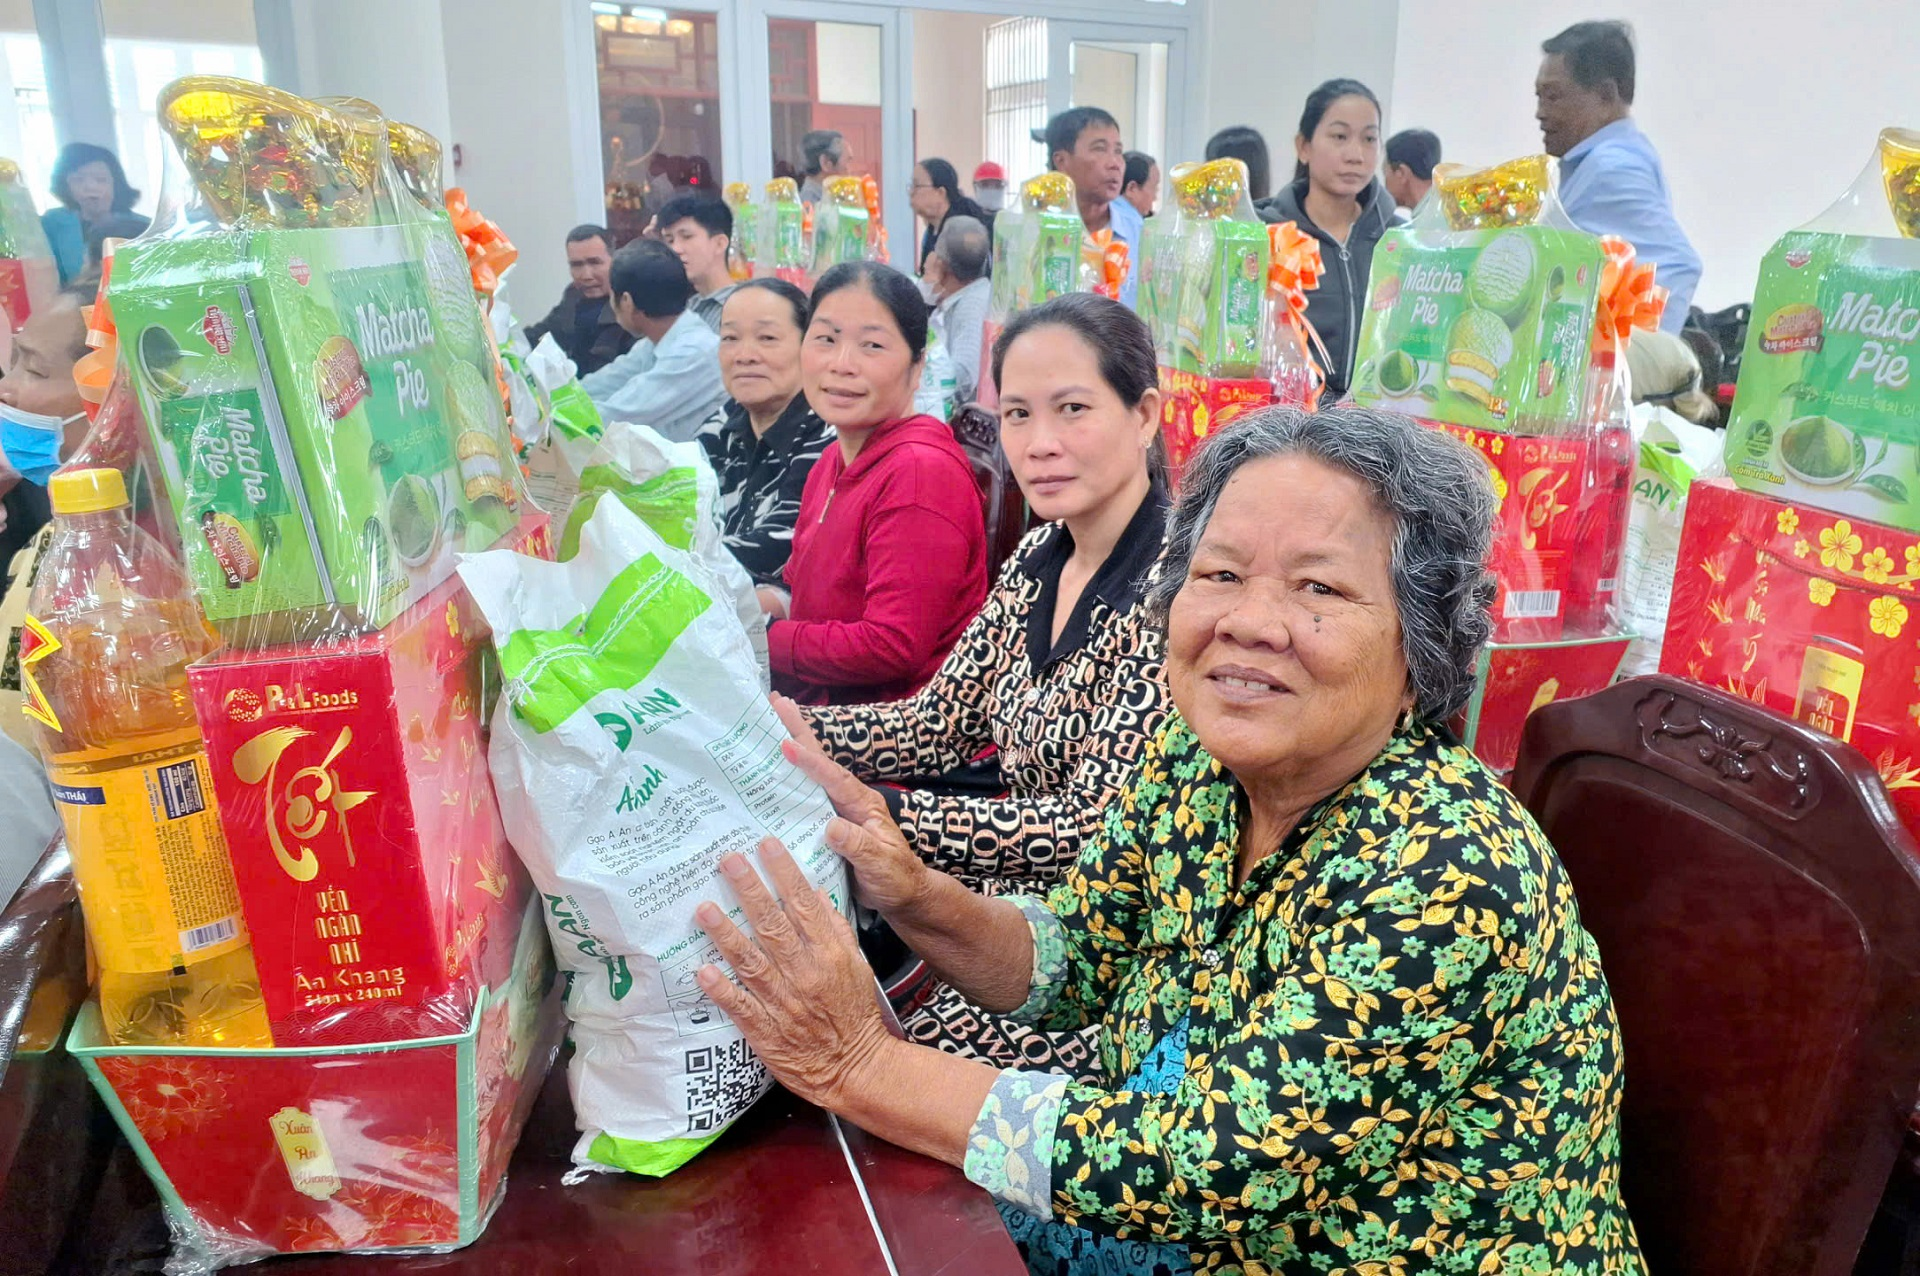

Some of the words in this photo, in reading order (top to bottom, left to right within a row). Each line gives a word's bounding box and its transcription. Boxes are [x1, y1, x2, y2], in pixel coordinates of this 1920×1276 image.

[1403, 263, 1464, 294] Matcha
[356, 292, 435, 362] Matcha
[1410, 296, 1439, 326] Pie
[1828, 292, 1920, 342] Matc
[1848, 341, 1910, 388] Pie
[393, 358, 430, 417] Pie
[203, 435, 231, 480] Pie
[220, 406, 270, 505] Matcha
[1633, 478, 1671, 506] AN
[1518, 466, 1570, 551] Tết
[313, 690, 359, 709] Foods
[232, 725, 378, 882] Tết
[746, 781, 766, 799] Năng
[753, 791, 779, 810] Protein
[587, 835, 606, 845] Gạo
[608, 830, 616, 840] A
[619, 827, 632, 837] An
[658, 796, 675, 817] chất
[762, 805, 781, 821] Gluxit
[796, 830, 813, 844] công
[818, 811, 835, 826] chất
[611, 838, 631, 851] xuất
[634, 833, 652, 844] trên
[653, 818, 673, 837] cánh
[628, 883, 648, 898] Gạo
[649, 877, 656, 888] A
[656, 872, 668, 883] An
[668, 861, 690, 876] được
[690, 851, 705, 864] sản
[703, 839, 720, 854] xuất
[634, 892, 657, 909] công
[658, 877, 680, 894] nghệ
[681, 867, 700, 881] hiện
[701, 856, 715, 870] đại
[315, 884, 350, 913] YẾN
[639, 910, 650, 921] ra
[650, 900, 667, 914] sản
[667, 886, 692, 906] phẩm
[692, 875, 710, 891] gạo
[726, 906, 744, 919] ƠM:
[575, 909, 591, 931] Ngon
[656, 937, 688, 963] HƯỚNG
[334, 966, 407, 986] Khang
[279, 1120, 314, 1136] Xuân
[294, 1145, 318, 1160] An
